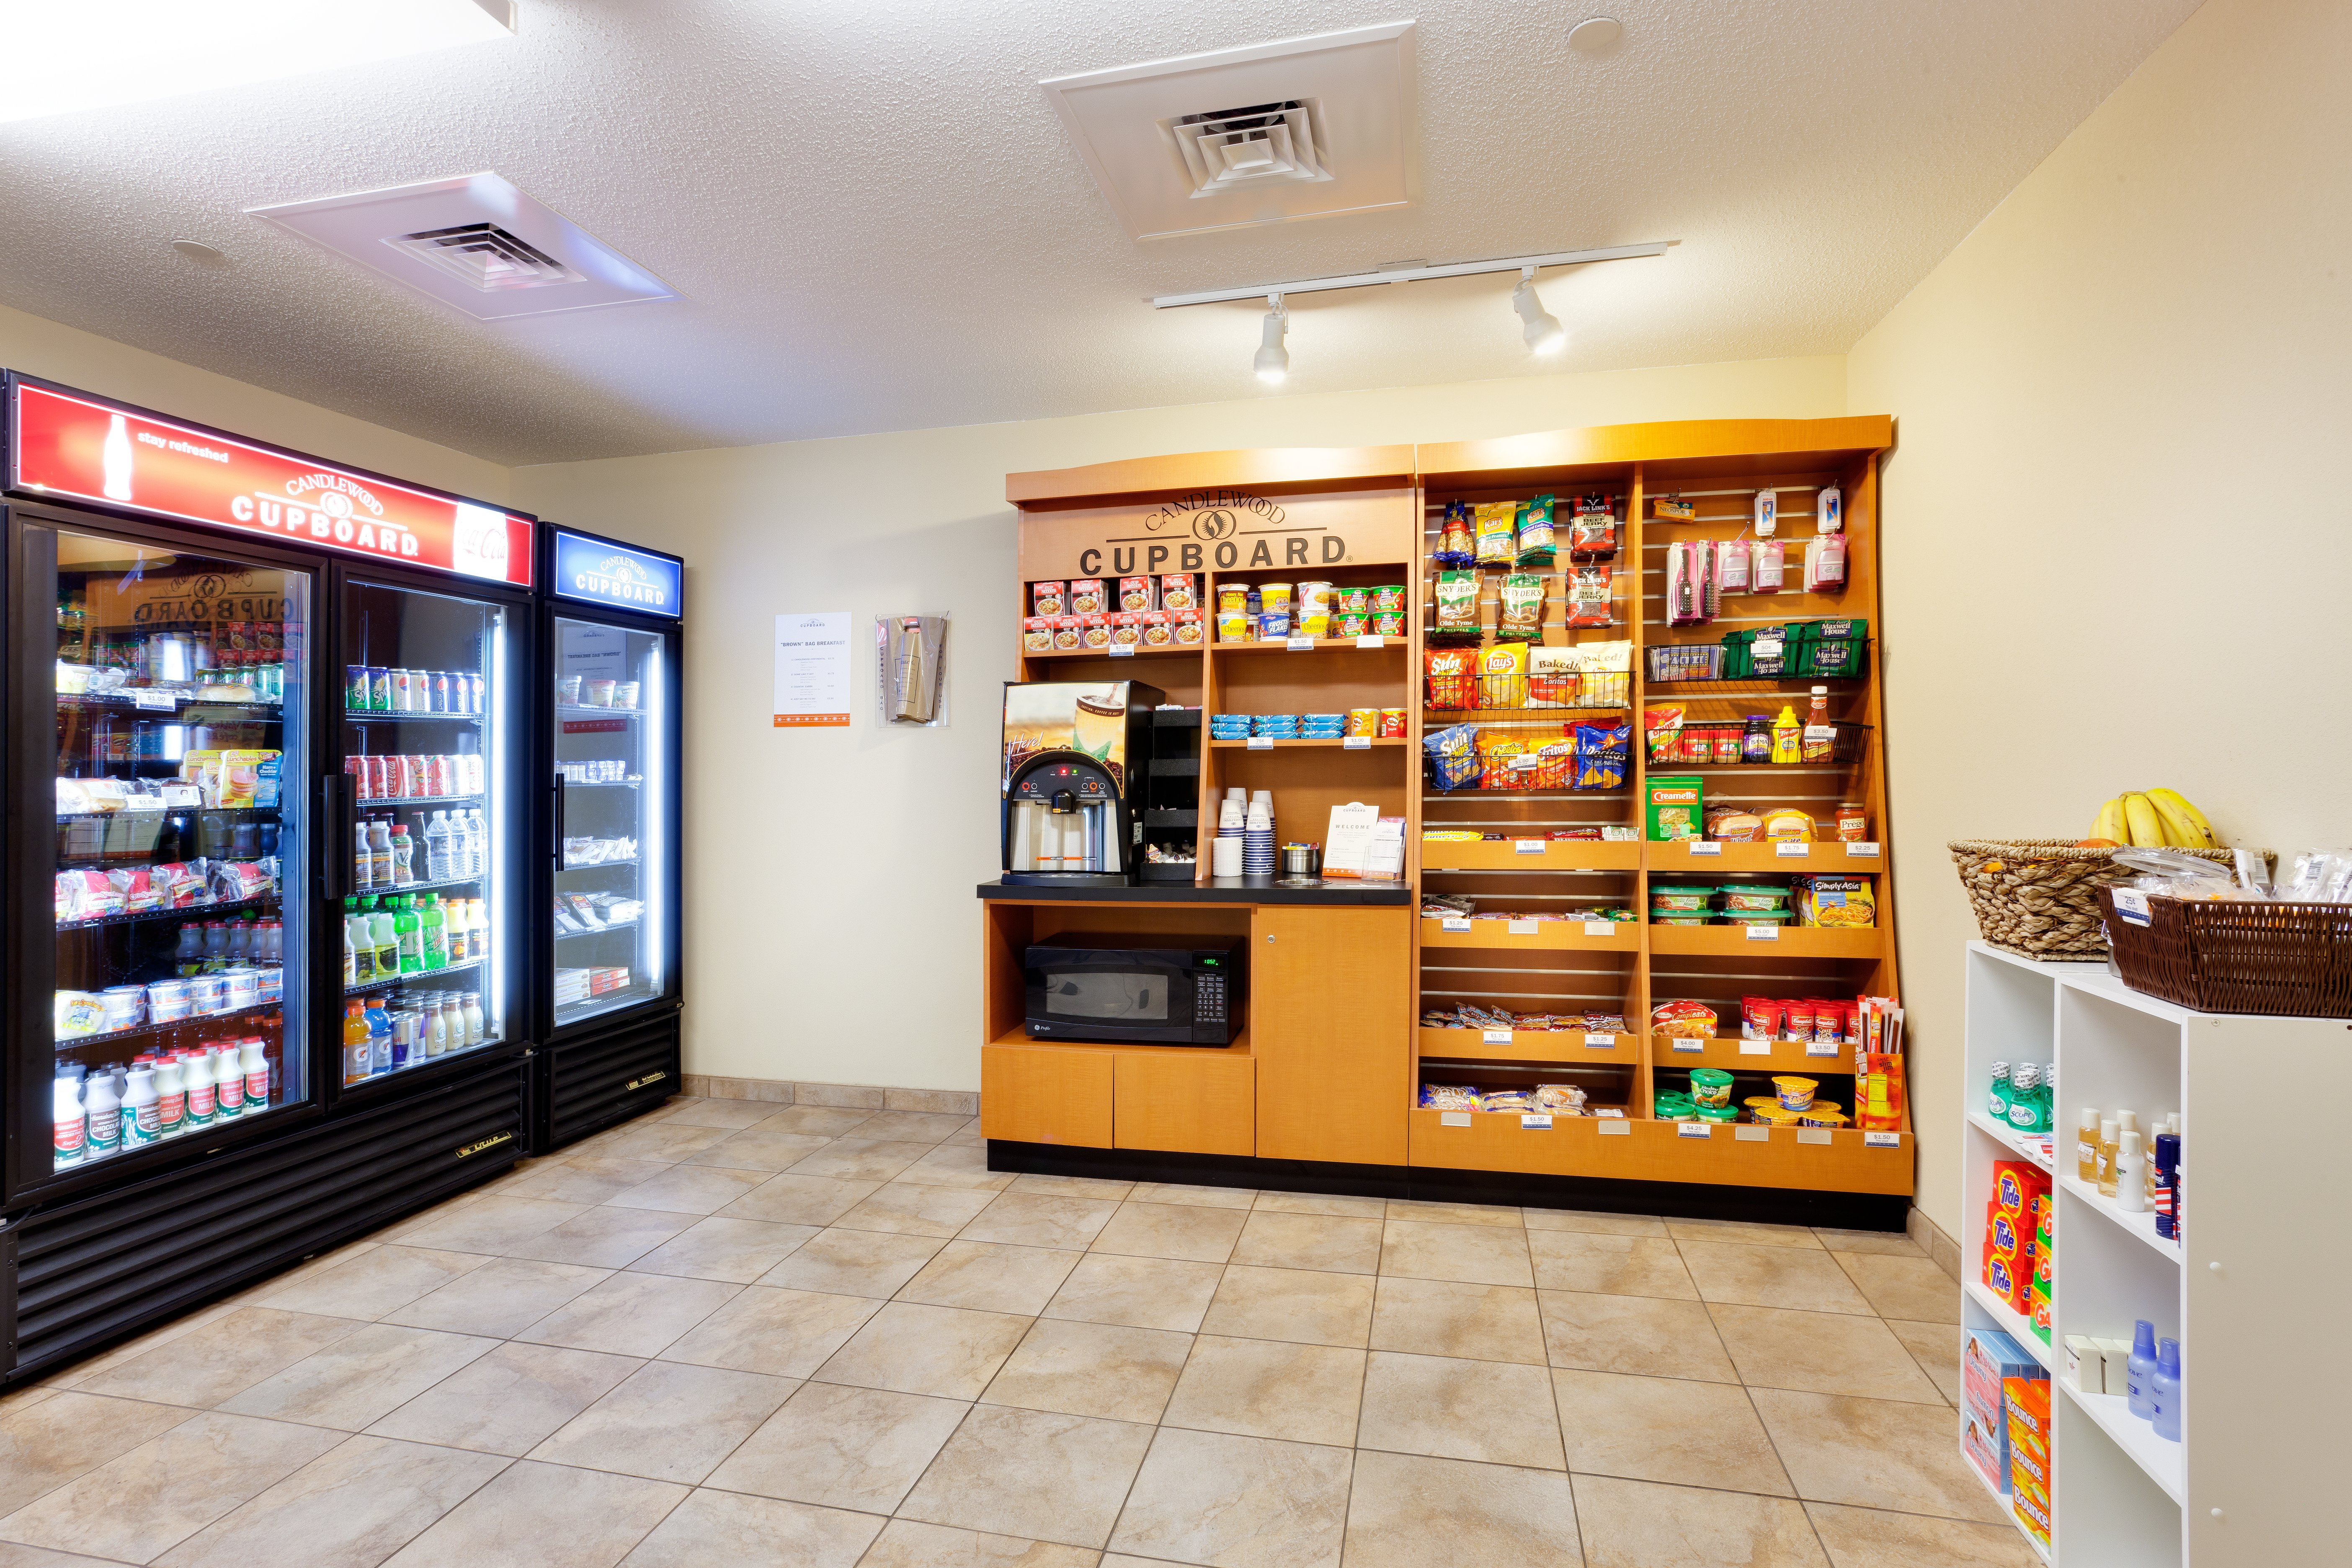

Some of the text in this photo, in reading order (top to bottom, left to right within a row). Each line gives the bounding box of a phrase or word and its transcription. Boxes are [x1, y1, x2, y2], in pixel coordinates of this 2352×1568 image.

[138, 433, 229, 463] stay refreshed
[286, 474, 384, 516] CANDLEWOOD
[1145, 490, 1285, 531] CANDLEWOOD
[1527, 508, 1545, 521] Kar's
[1660, 506, 1692, 516] NEOSPORN
[231, 495, 418, 556] CUPBOARD
[1484, 517, 1503, 529] Kar's
[1080, 536, 1346, 575] CUPBOARD
[600, 556, 647, 580] CANDLEWOOD
[576, 574, 665, 605] CUPBOARD
[1268, 624, 1288, 634] FLAKES
[1821, 622, 1851, 632] Maxwell
[1756, 631, 1785, 641] Maxwell
[1488, 655, 1514, 670] Lay's
[1583, 654, 1622, 664] Baked!
[1671, 655, 1689, 665] ACT
[1816, 650, 1847, 660] Maxwell
[1819, 655, 1841, 664] House
[1431, 654, 1461, 676] Sun
[1539, 660, 1579, 671] Baked!
[1754, 660, 1784, 670] Maxwell
[1757, 666, 1779, 675] House
[1010, 731, 1044, 753] Here!
[1440, 732, 1467, 757] Sun
[1720, 743, 1735, 752] Jif
[1490, 744, 1524, 761] Cheetos
[1538, 744, 1569, 761] Fritos
[1587, 746, 1626, 761] Doritos
[1653, 791, 1696, 801] Creamette
[1841, 820, 1865, 830] Prego
[2125, 896, 2135, 905] 25¢
[1672, 1011, 1707, 1021] Compleats
[643, 1075, 663, 1083] FREEZER
[198, 1101, 214, 1110] MILK
[1788, 1096, 1803, 1105] EASY
[161, 1108, 180, 1118] MILK
[474, 1136, 499, 1151] true
[2001, 1178, 2020, 1207] Tide
[1995, 1219, 2014, 1249] Tide
[2026, 1241, 2036, 1256] Tide
[1991, 1261, 2011, 1292] Tide
[1969, 1354, 1987, 1382] Downy
[1976, 1391, 1994, 1423] Downy
[2005, 1392, 2040, 1435] Bounce
[1969, 1436, 1987, 1467] Downy
[2011, 1440, 2044, 1484] Bounce
[2014, 1485, 2050, 1532] Bounce
